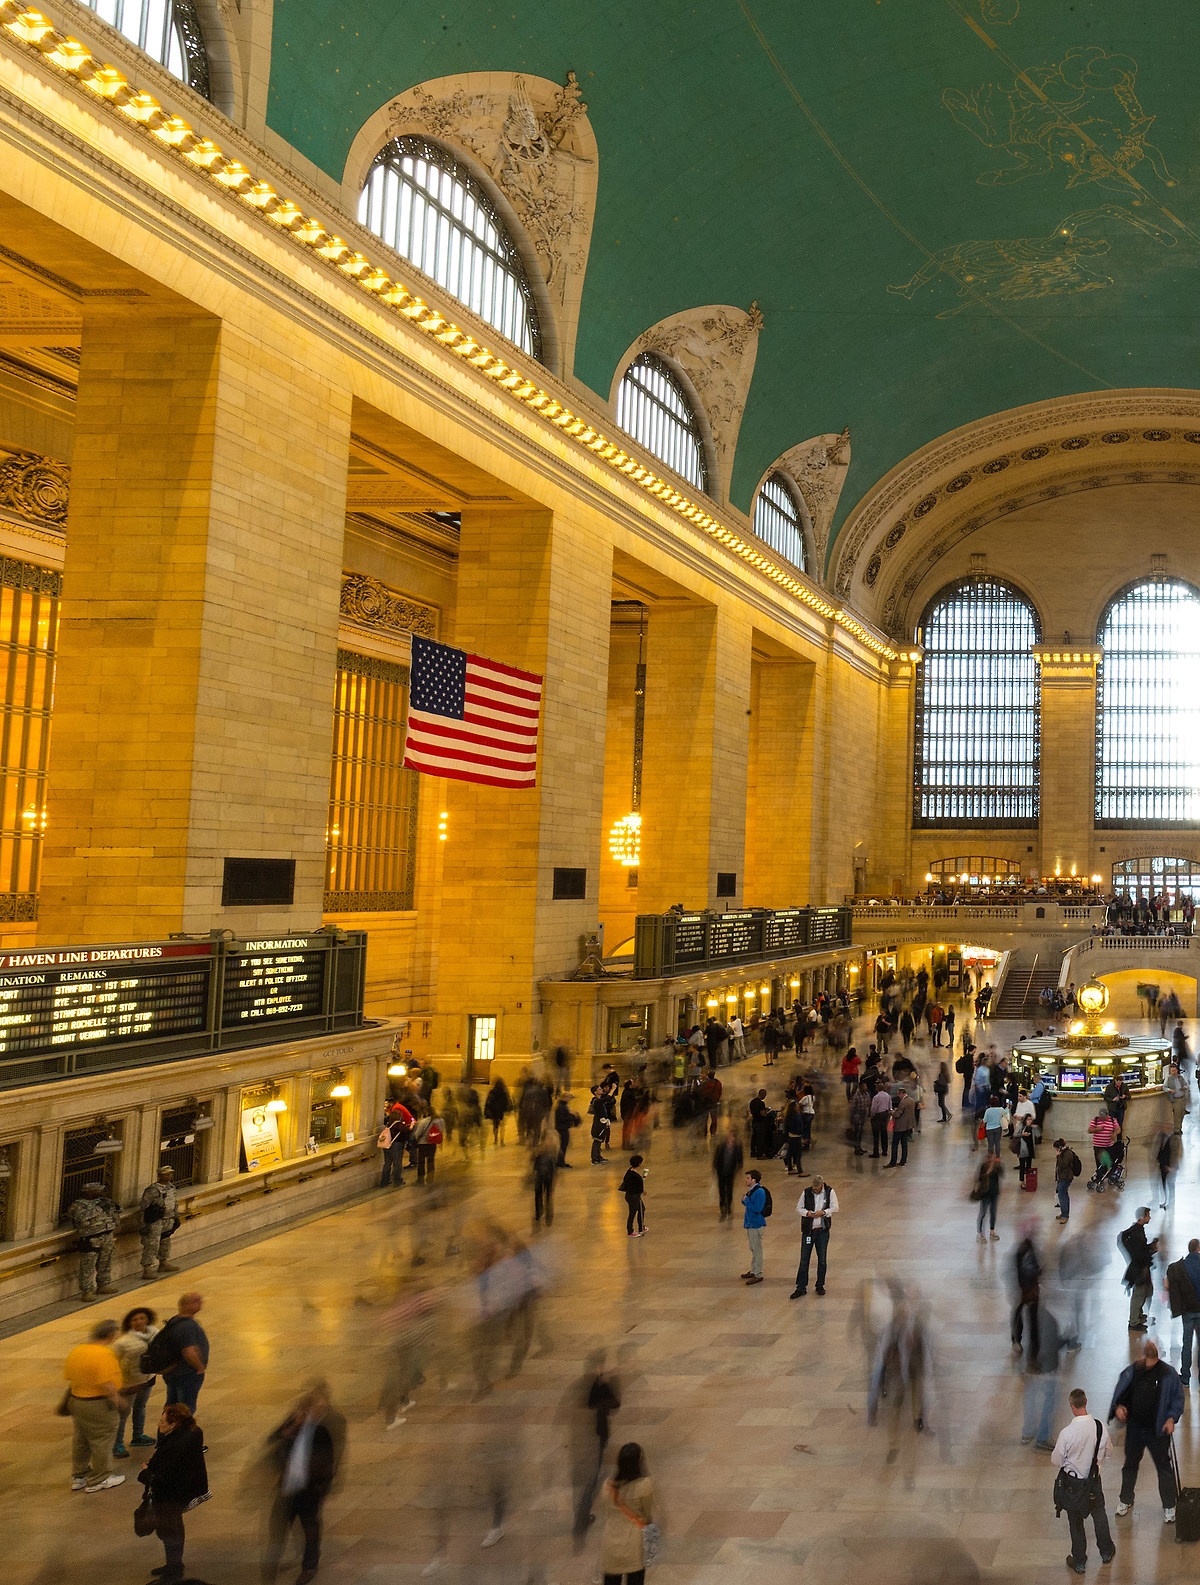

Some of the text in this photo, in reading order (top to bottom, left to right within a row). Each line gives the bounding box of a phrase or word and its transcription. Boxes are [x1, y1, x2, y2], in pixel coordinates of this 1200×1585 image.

[245, 939, 308, 951] INFORMATION
[8, 953, 56, 967] HAVEN
[58, 951, 89, 964] LINE
[90, 947, 163, 961] DEPARTURES
[240, 959, 248, 967] IF
[250, 958, 261, 966] YOU
[262, 957, 273, 965] SEE
[60, 969, 107, 982] REMARKS
[252, 968, 263, 976] SAY
[104, 981, 119, 990] 1ST
[120, 979, 139, 989] STOP
[239, 979, 257, 988] ALERT
[264, 976, 285, 985] POLICE
[285, 974, 308, 983] OFFICER
[269, 987, 278, 995] OR
[54, 997, 70, 1008] RYE
[82, 995, 97, 1004] 1ST
[98, 992, 118, 1003] STOP
[266, 995, 292, 1005] EMPLOYEE
[103, 1004, 117, 1014] 1ST
[118, 1002, 137, 1012] STOP
[240, 1010, 249, 1018] OR
[250, 1008, 265, 1017] CALL
[52, 1021, 68, 1032] NEW
[70, 1017, 108, 1030] ROCHELLE
[118, 1014, 133, 1024] 1ST
[134, 1012, 153, 1022] STOP
[52, 1033, 77, 1044] MOUNT
[79, 1029, 107, 1041] VERNON
[118, 1026, 132, 1036] 1ST
[133, 1023, 152, 1033] STOP
